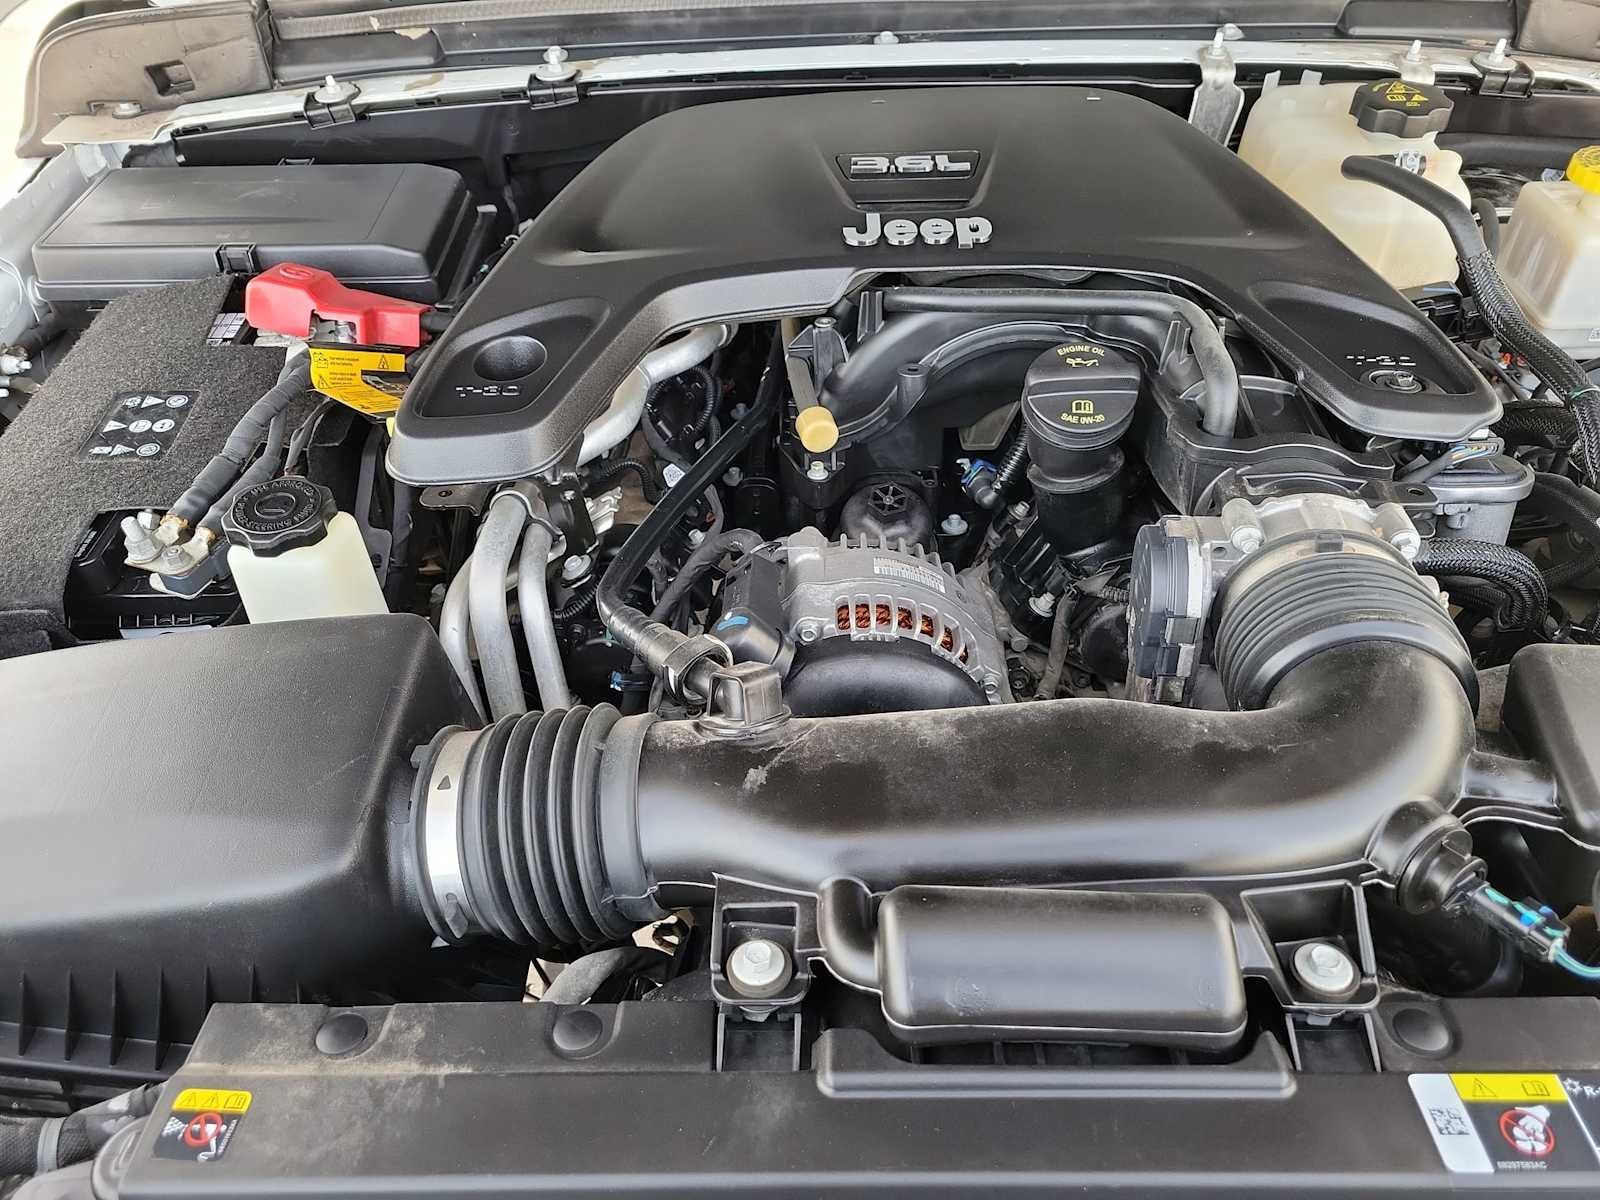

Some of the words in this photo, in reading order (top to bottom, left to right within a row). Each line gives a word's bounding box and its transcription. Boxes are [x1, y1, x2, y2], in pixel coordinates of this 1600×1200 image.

[850, 154, 971, 174] 3.6L
[842, 213, 993, 249] Jeep
[1057, 345, 1090, 356] ENGINE
[1092, 347, 1105, 357] OIL
[1060, 412, 1079, 424] SAE
[1080, 414, 1105, 424] 0W-20
